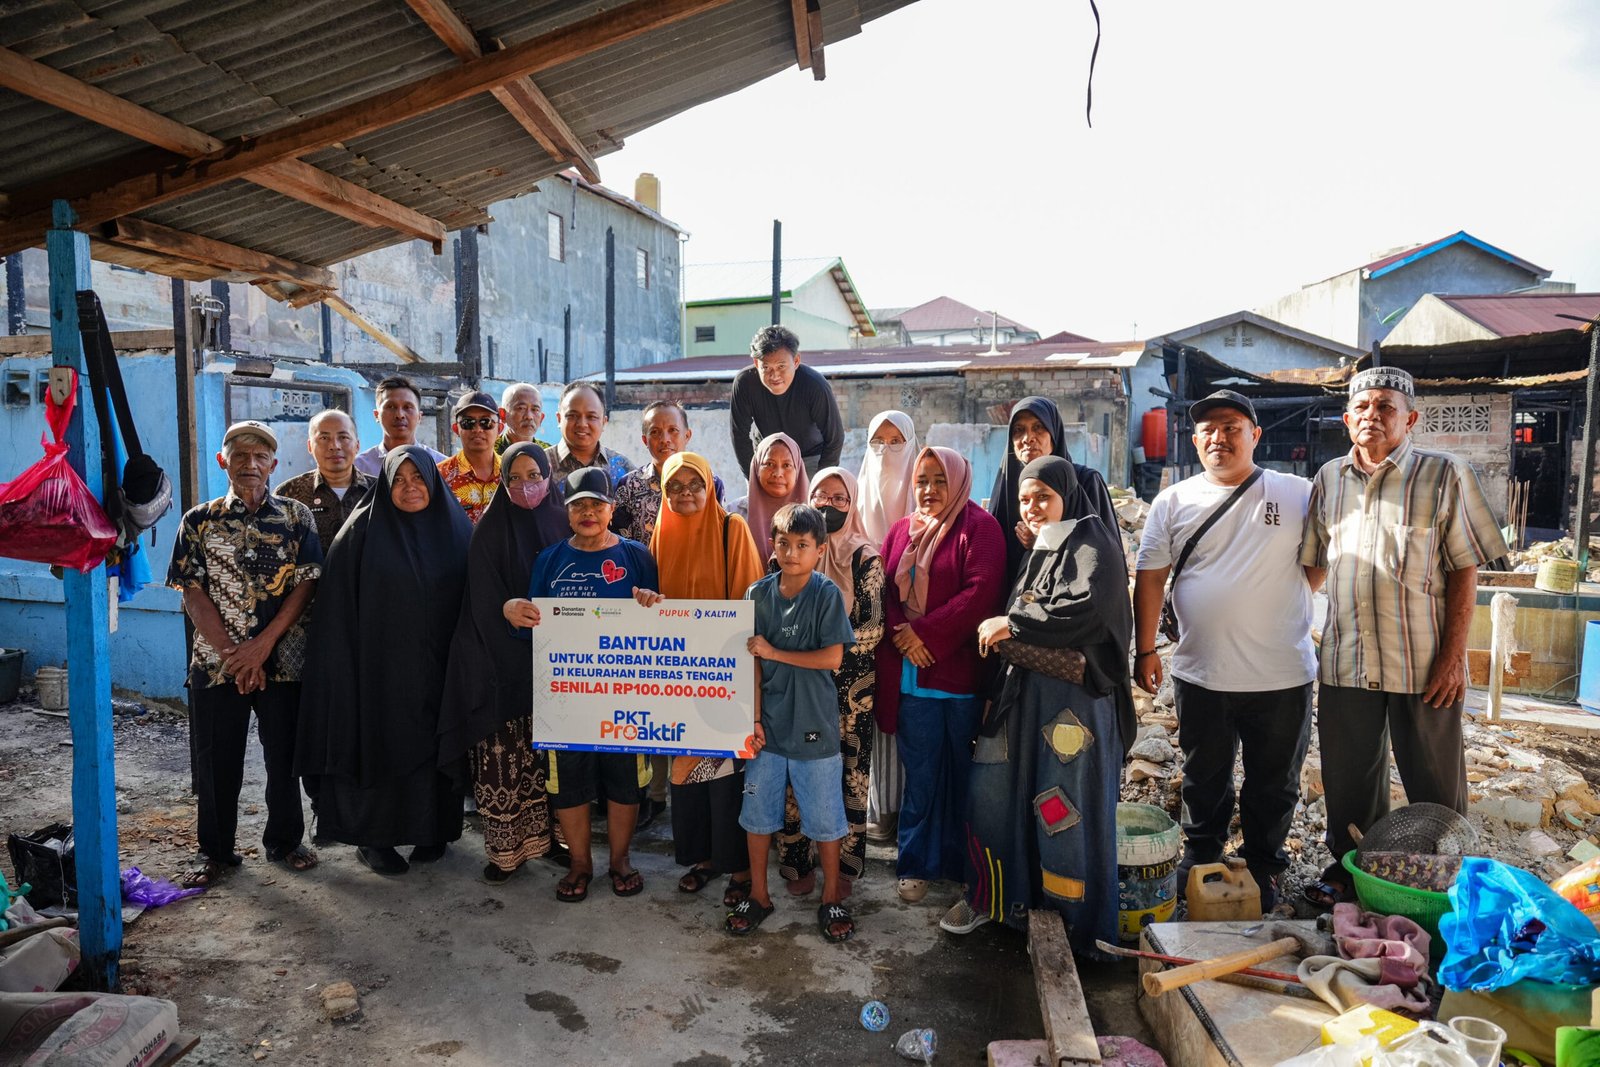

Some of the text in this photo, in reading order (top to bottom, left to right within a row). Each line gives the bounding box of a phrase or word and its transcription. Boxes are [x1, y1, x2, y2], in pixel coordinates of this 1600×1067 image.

[1266, 502, 1278, 514] RI
[1264, 513, 1281, 526] SE
[659, 609, 737, 618] PUPUK KALTIM
[599, 635, 686, 652] BANTUAN
[549, 653, 736, 669] UNTUK KORBAN KEBAKARAN
[553, 667, 733, 682] DI KELURAHAN BERBAS TENGAH
[550, 680, 736, 701] SENILAI RP100.000.000,-
[614, 710, 651, 726] PKT
[600, 720, 686, 742] Proaktif
[139, 1029, 167, 1058] TONASA
